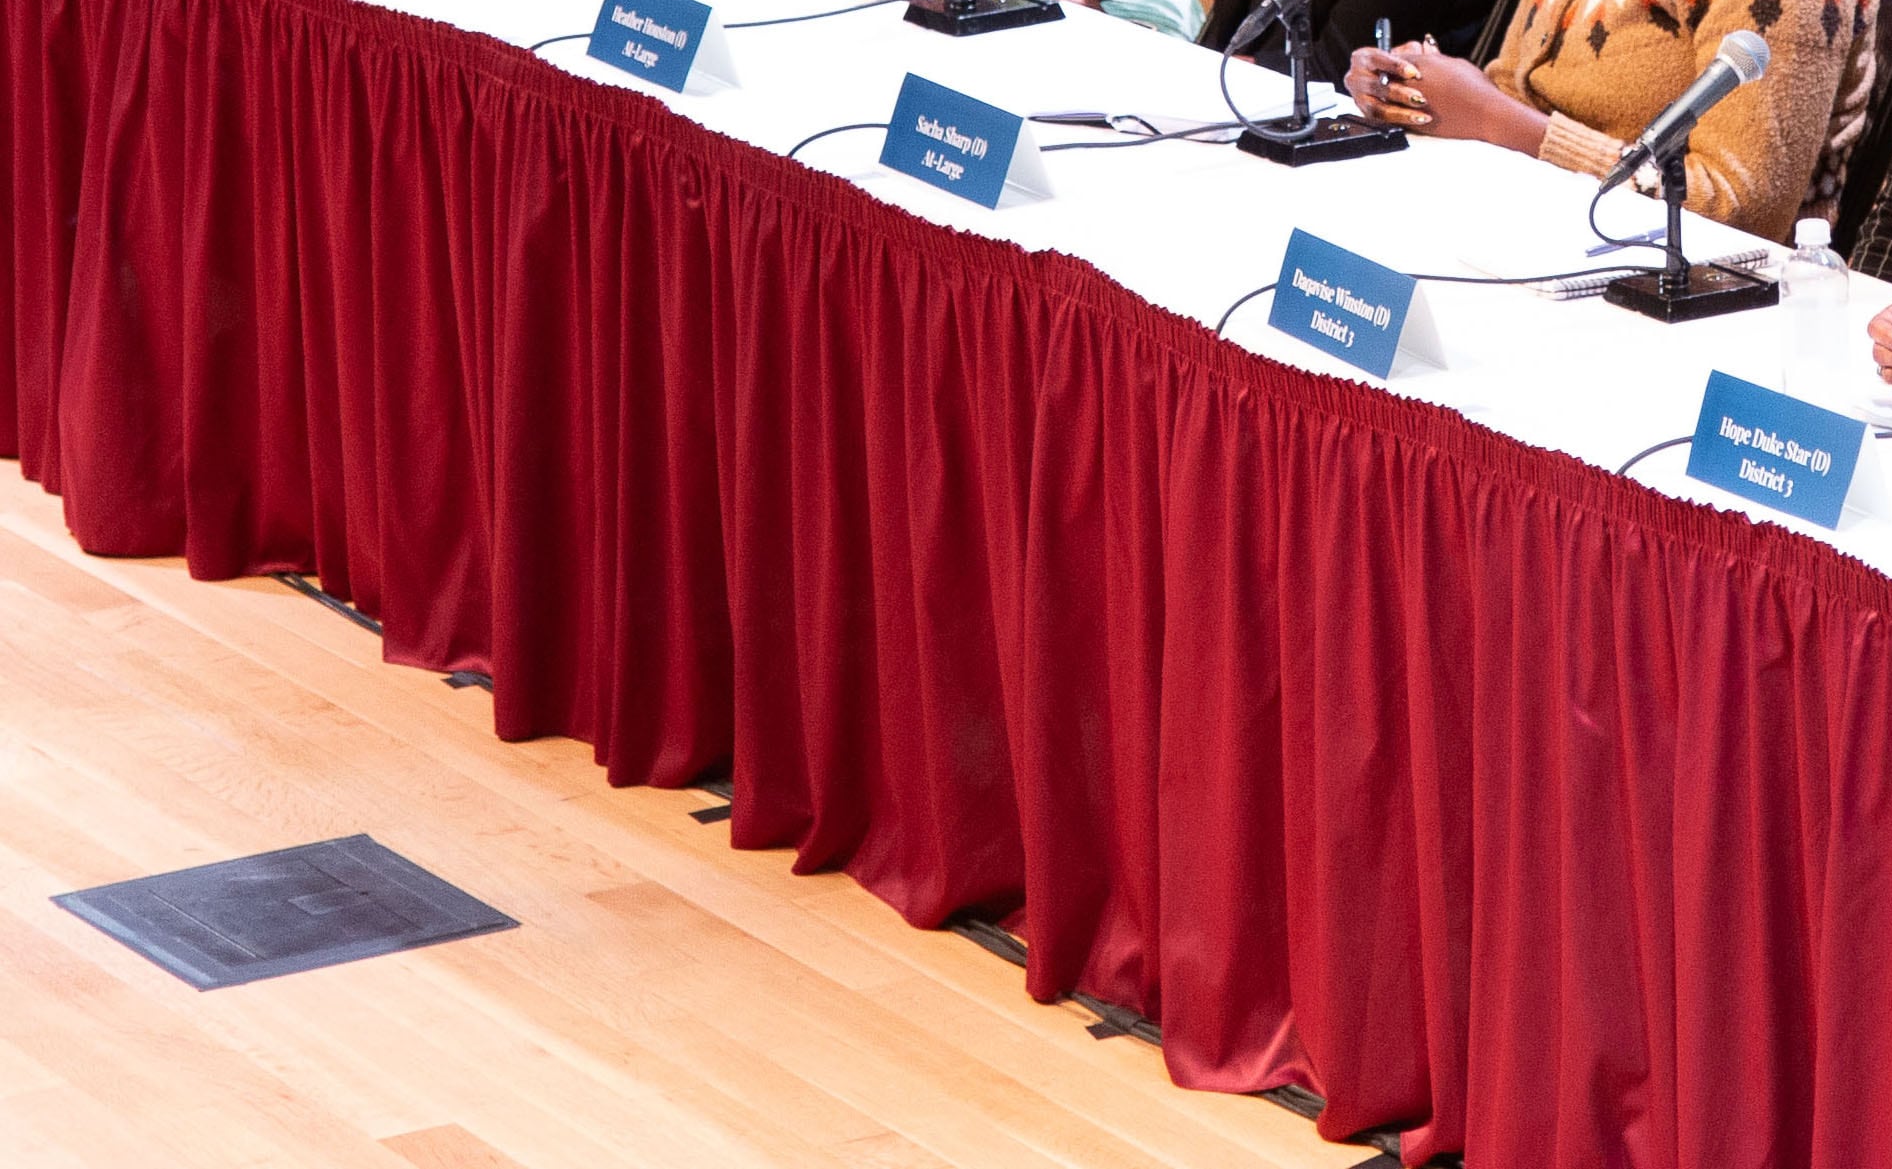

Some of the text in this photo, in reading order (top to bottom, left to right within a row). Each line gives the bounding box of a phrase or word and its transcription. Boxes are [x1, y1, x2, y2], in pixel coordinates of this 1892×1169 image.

[612, 5, 644, 32] Heather
[621, 39, 659, 68] At-Large
[916, 115, 988, 160] Sacha Sharp (D)
[921, 149, 964, 180] At-Large
[1335, 287, 1374, 321] Winston
[1373, 304, 1391, 331] (D)
[1310, 310, 1355, 348] District 3
[1719, 416, 1832, 477] Hope Duke Star (D)
[1739, 458, 1794, 498] District 3
